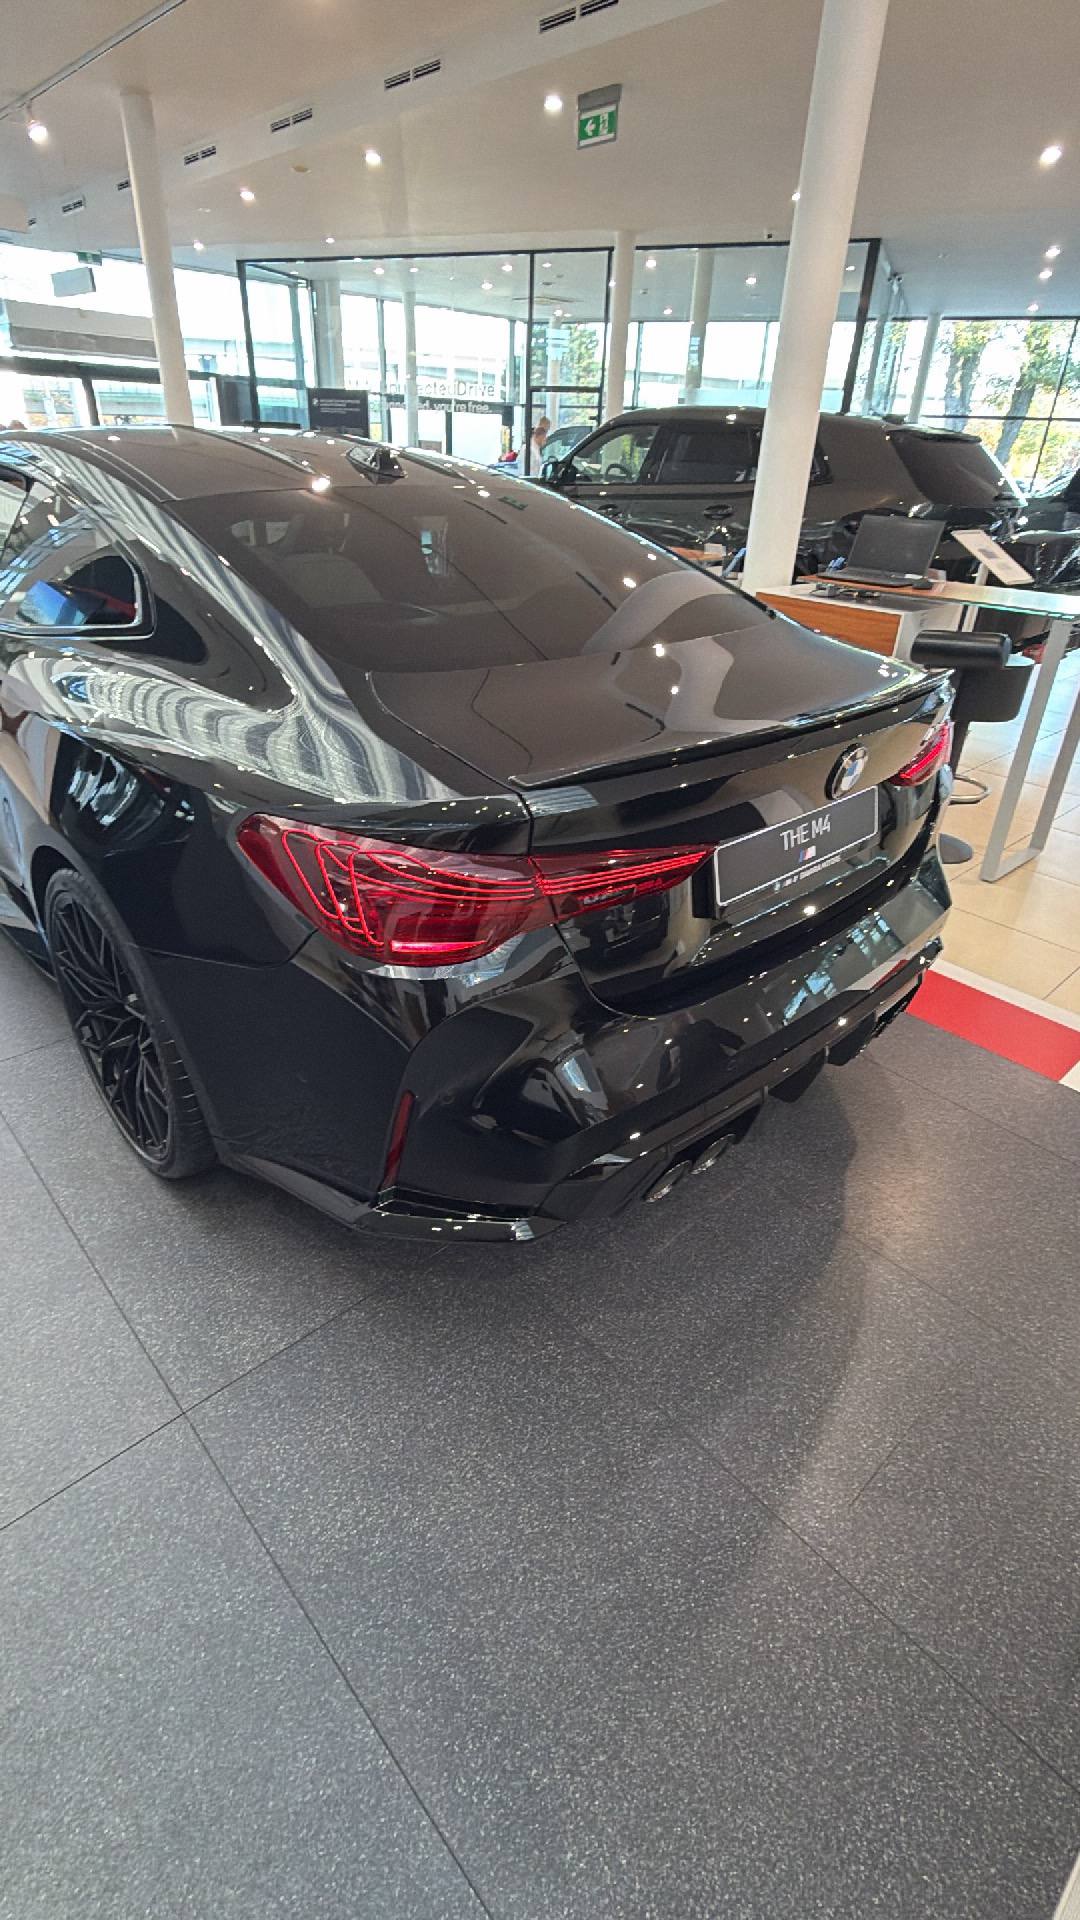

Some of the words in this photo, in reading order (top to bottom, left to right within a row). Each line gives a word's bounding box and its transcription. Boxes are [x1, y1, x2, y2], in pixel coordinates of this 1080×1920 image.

[379, 380, 495, 397] onectedDrive
[780, 822, 810, 850] THE
[812, 814, 831, 838] M4
